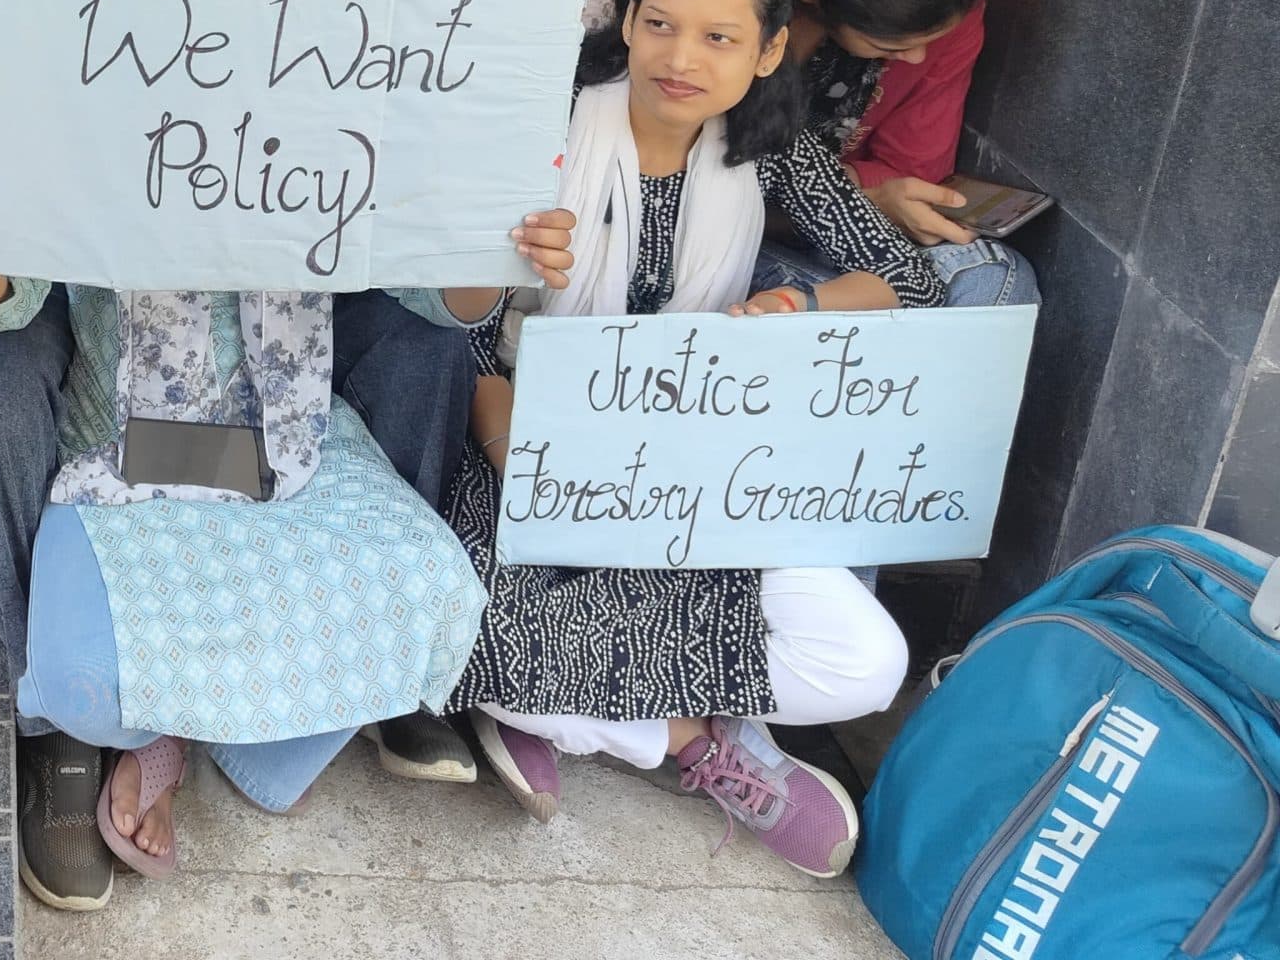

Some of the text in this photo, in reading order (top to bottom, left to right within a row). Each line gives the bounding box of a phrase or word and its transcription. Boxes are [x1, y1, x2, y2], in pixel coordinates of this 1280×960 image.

[144, 111, 377, 277] Policy.
[588, 320, 920, 419] Justice For
[506, 440, 970, 568] Forestry Graduates.
[971, 704, 1160, 960] METRONA
